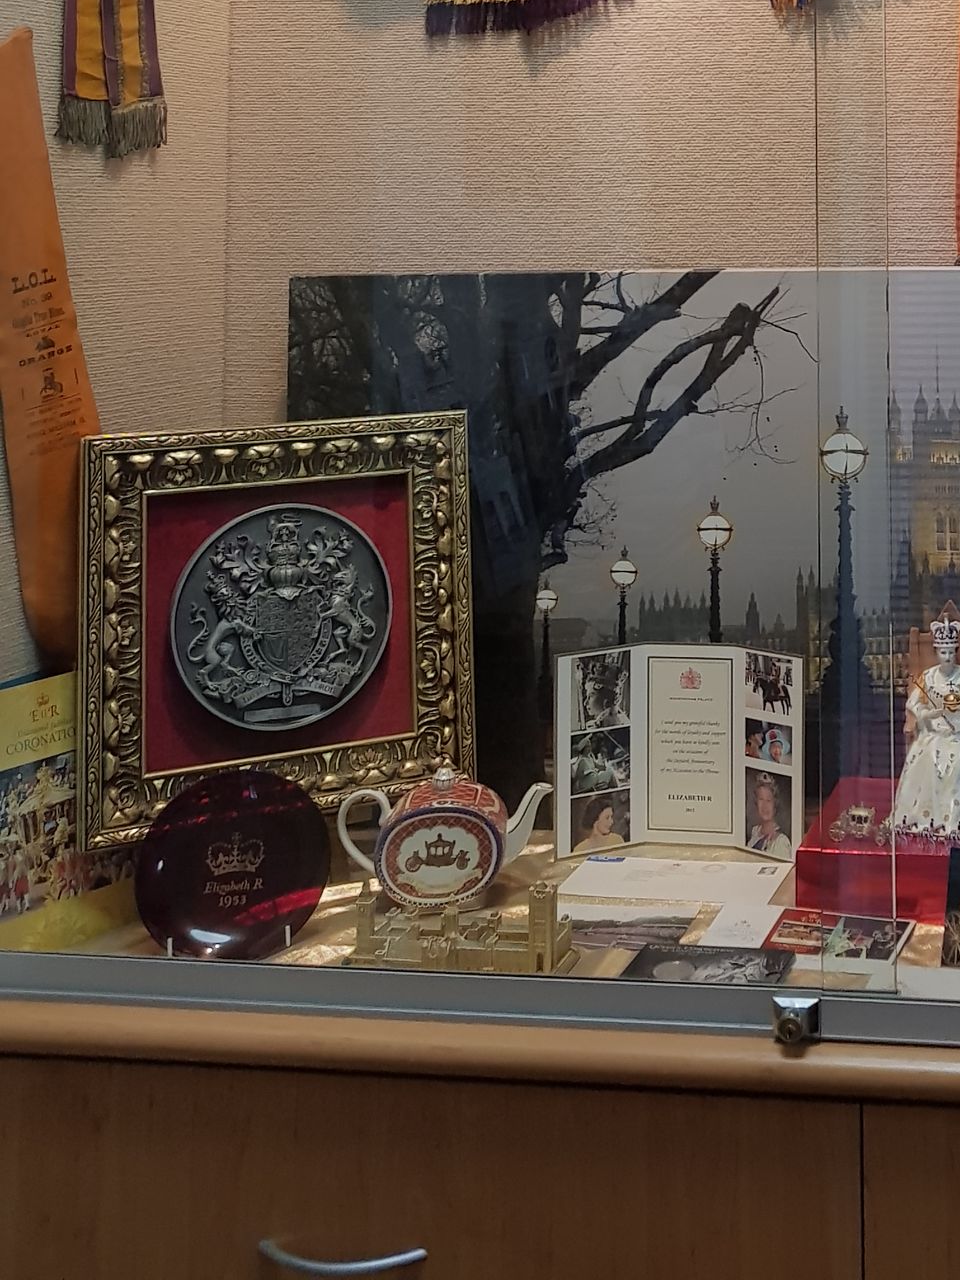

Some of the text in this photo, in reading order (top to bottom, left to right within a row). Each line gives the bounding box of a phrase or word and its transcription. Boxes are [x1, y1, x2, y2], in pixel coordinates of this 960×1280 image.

[203, 878, 263, 896] Elizabeth R
[219, 895, 247, 908] 1953
